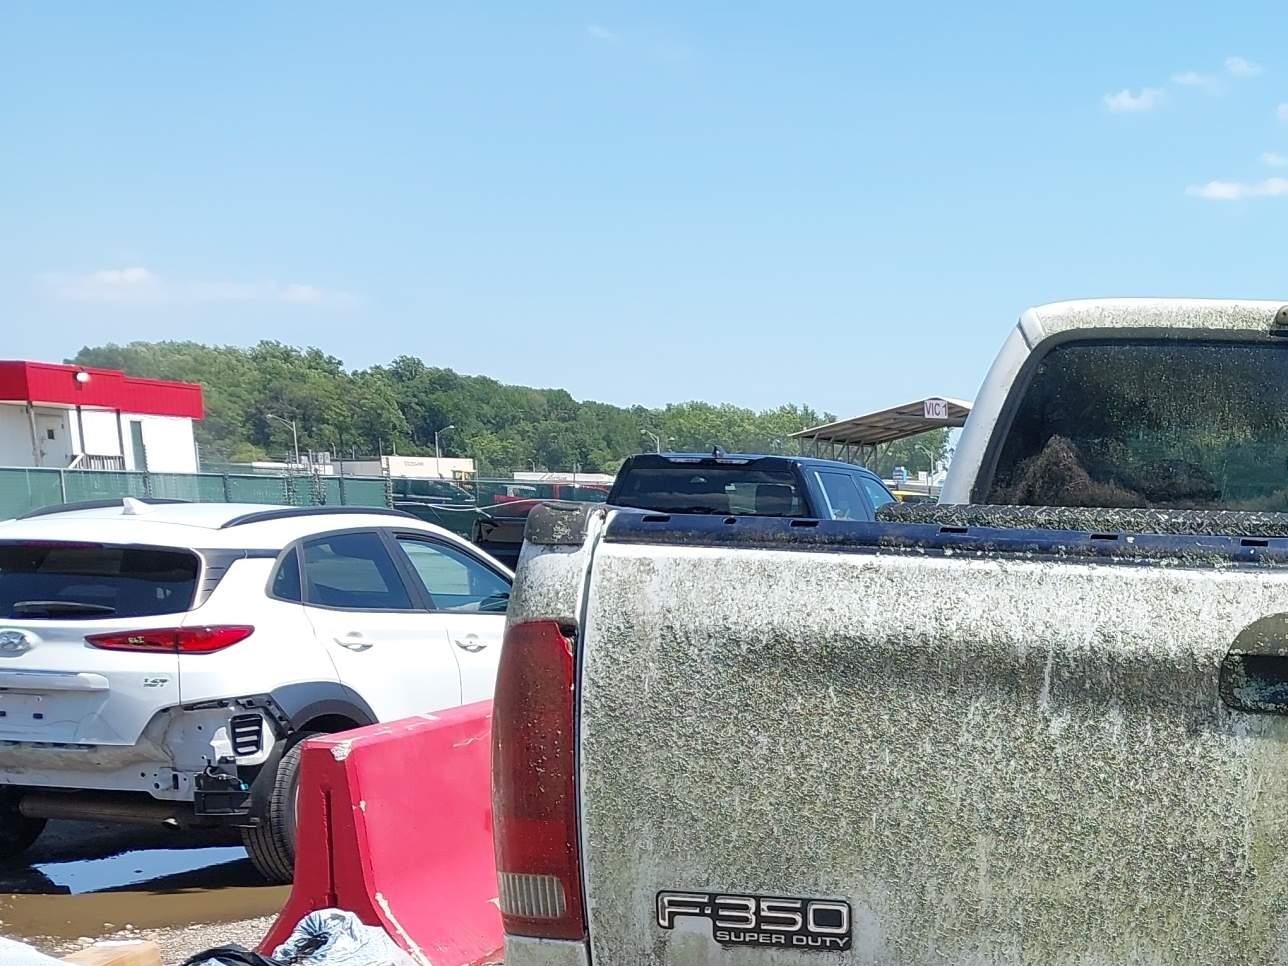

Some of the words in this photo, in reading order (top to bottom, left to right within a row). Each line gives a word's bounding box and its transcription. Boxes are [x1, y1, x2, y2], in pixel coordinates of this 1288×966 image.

[925, 402, 941, 417] VIC
[716, 931, 786, 945] SUPER
[792, 935, 850, 947] DUTY
